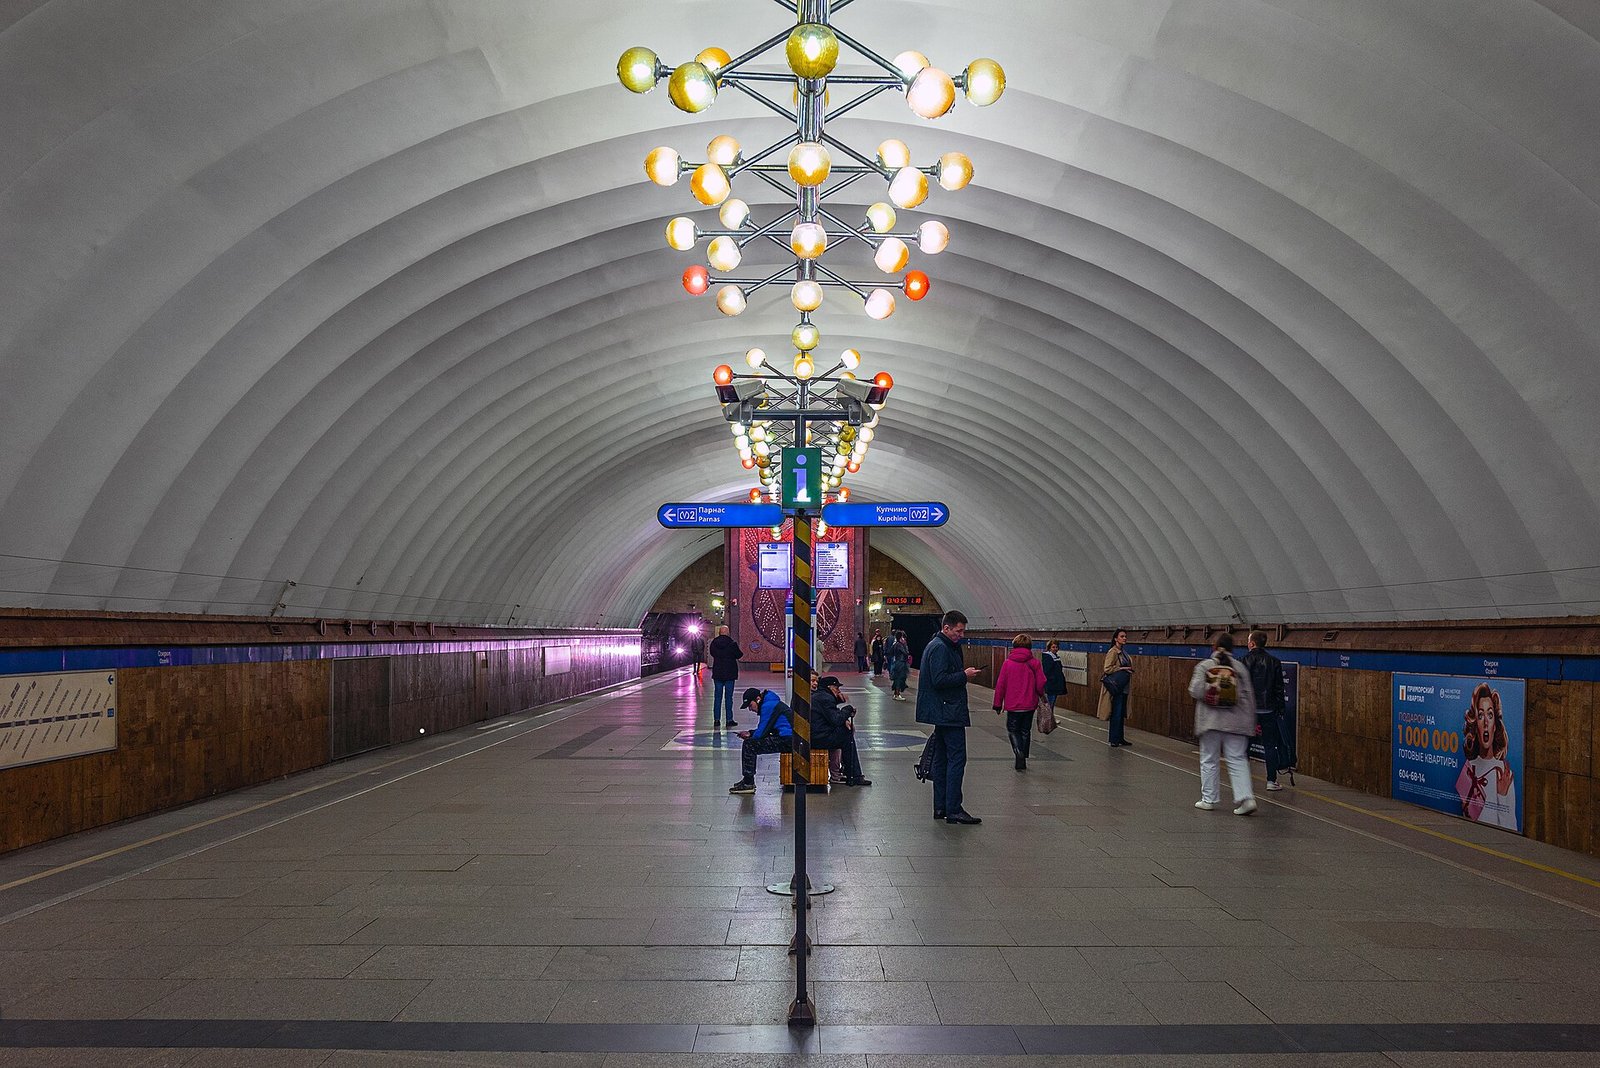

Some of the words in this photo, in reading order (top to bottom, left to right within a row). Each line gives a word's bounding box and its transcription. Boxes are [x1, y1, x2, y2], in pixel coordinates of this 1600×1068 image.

[698, 506, 725, 514] Парнас
[876, 506, 908, 514] Купчино
[877, 515, 908, 523] Kupchino
[1407, 685, 1435, 694] ПРИМОРСКИЙ
[1407, 694, 1425, 703] КВАРТАЛ
[1399, 712, 1425, 725] ПОДАРОК
[1426, 715, 1436, 725] НА
[1398, 724, 1403, 744] 1
[1405, 726, 1429, 748] 000
[1432, 729, 1459, 753] 000
[1399, 749, 1424, 763] ГОТОВЫЕ
[1425, 754, 1458, 768] КВАРТИРЫ
[1399, 769, 1425, 783] 604-68-14
